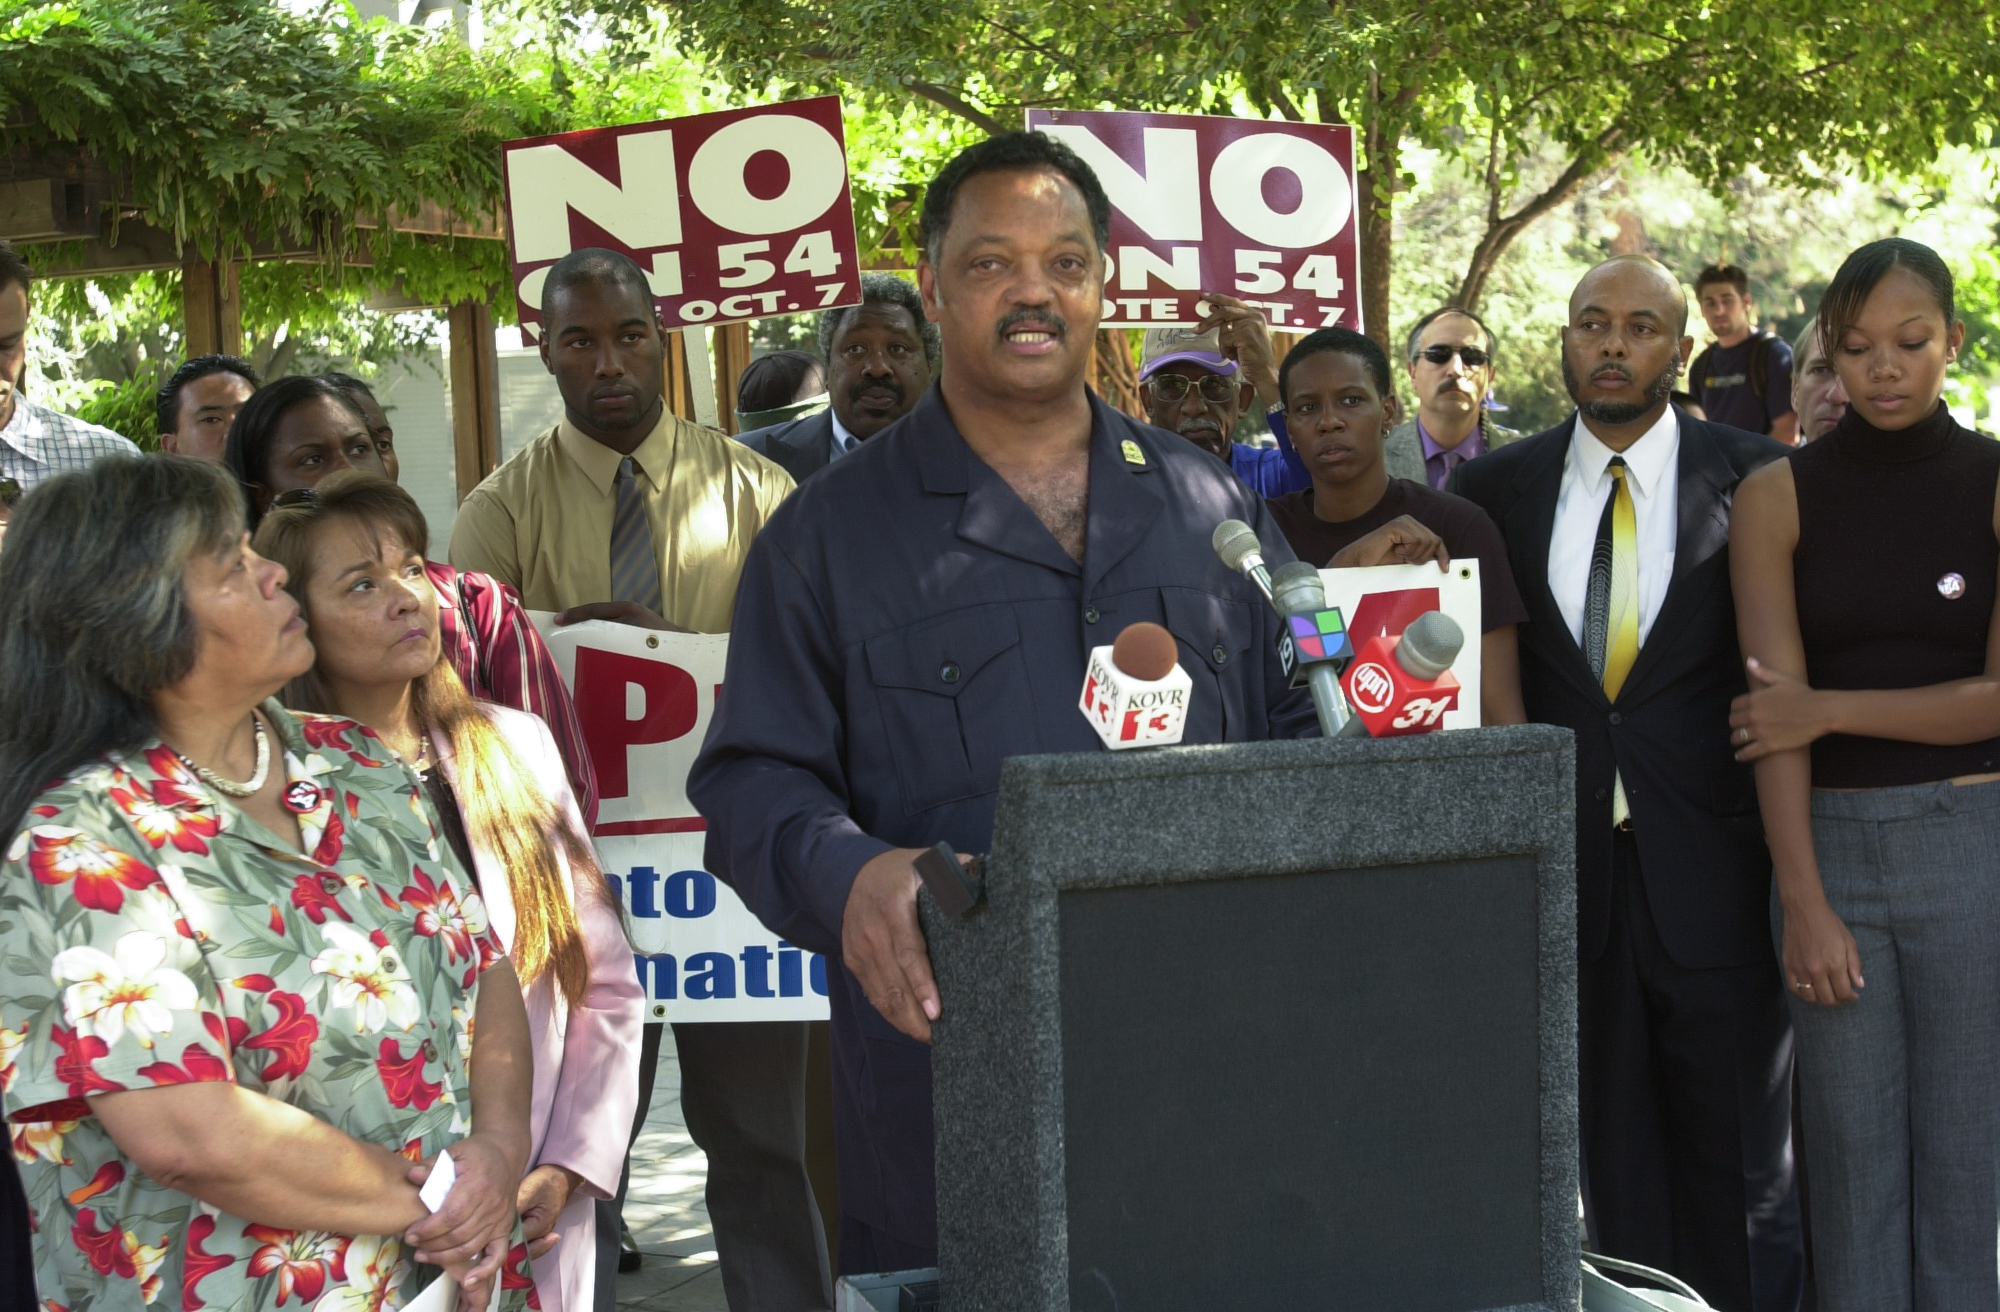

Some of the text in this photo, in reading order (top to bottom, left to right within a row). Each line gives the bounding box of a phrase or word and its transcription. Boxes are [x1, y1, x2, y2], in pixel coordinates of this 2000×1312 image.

[506, 114, 845, 263] NO
[1033, 124, 1352, 249] NO
[717, 230, 842, 288] 54
[1102, 246, 1344, 299] N 54
[678, 282, 846, 322] OCT. 7
[1318, 306, 1346, 327] 7
[1128, 689, 1183, 709] KOVR
[1392, 695, 1453, 729] 31
[1120, 705, 1183, 741] 13
